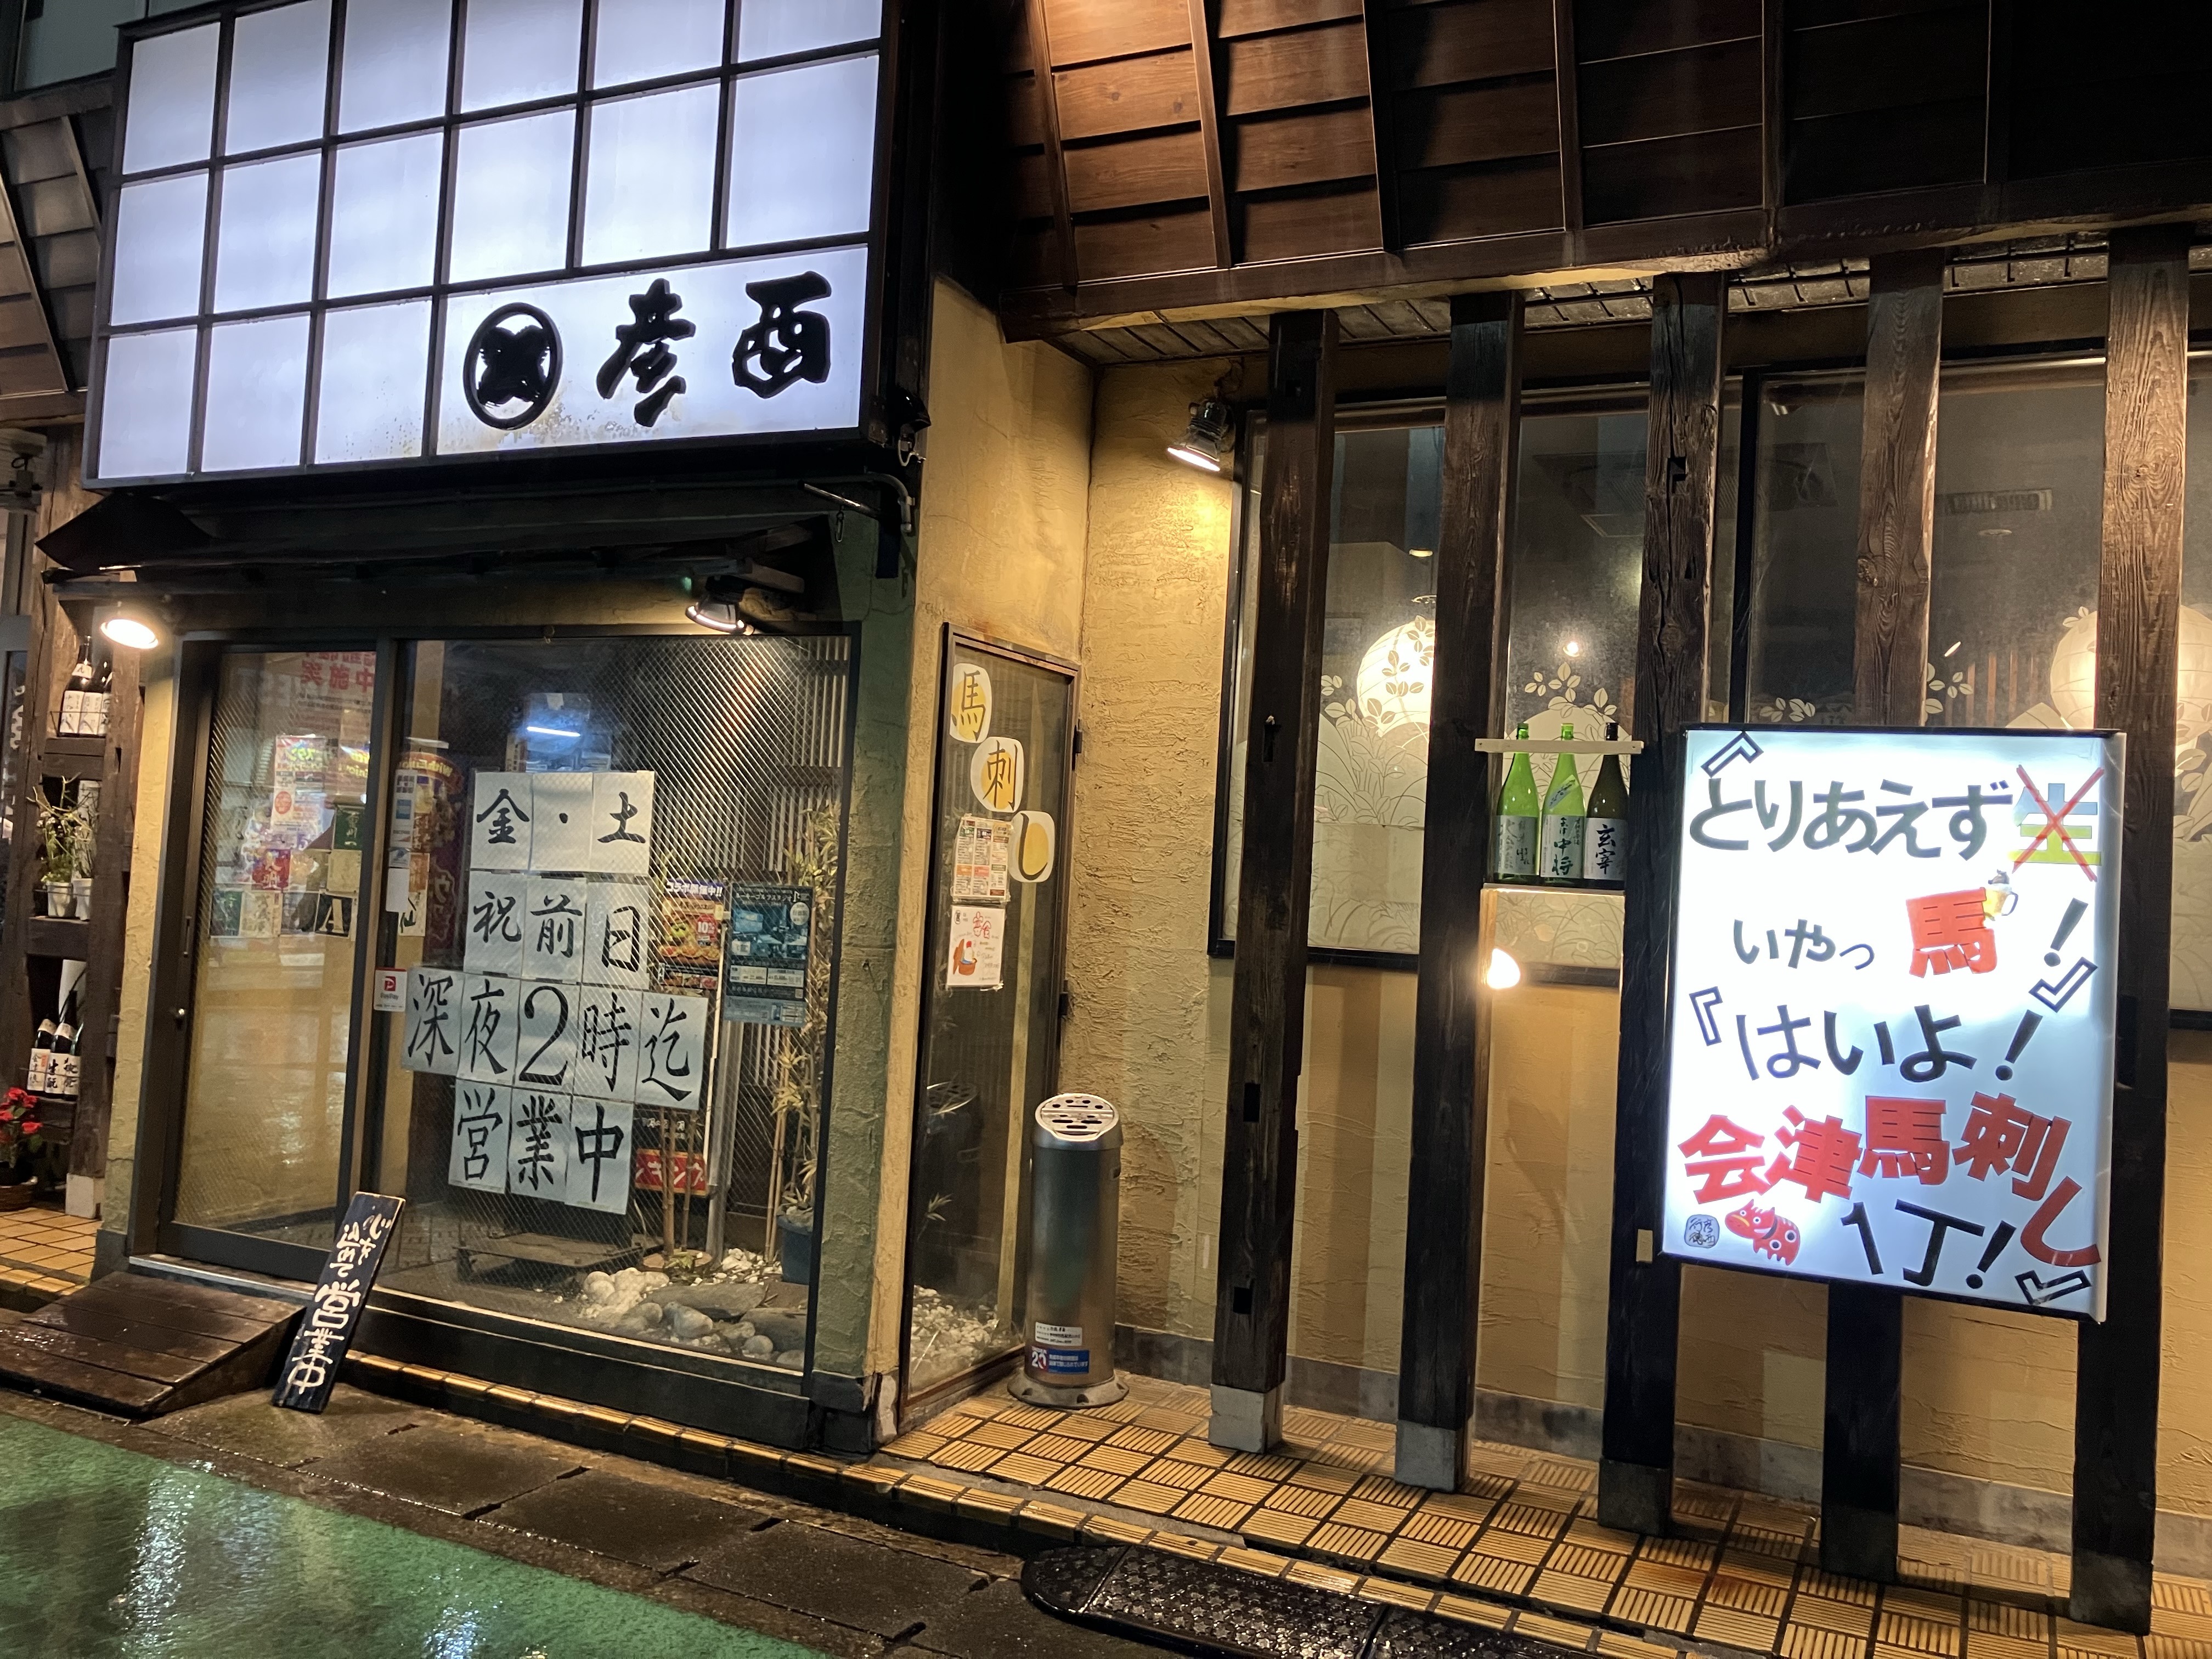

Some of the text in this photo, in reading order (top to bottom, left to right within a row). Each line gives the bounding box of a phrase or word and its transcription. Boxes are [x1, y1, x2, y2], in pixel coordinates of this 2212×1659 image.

[476, 788, 646, 844] 金・土
[472, 891, 641, 973] 祝前日
[408, 974, 692, 1102] 深夜2時迄
[458, 1087, 624, 1203] 営業中
[1678, 1091, 2101, 1269] 会津馬刺し
[287, 1279, 363, 1395] 営業中
